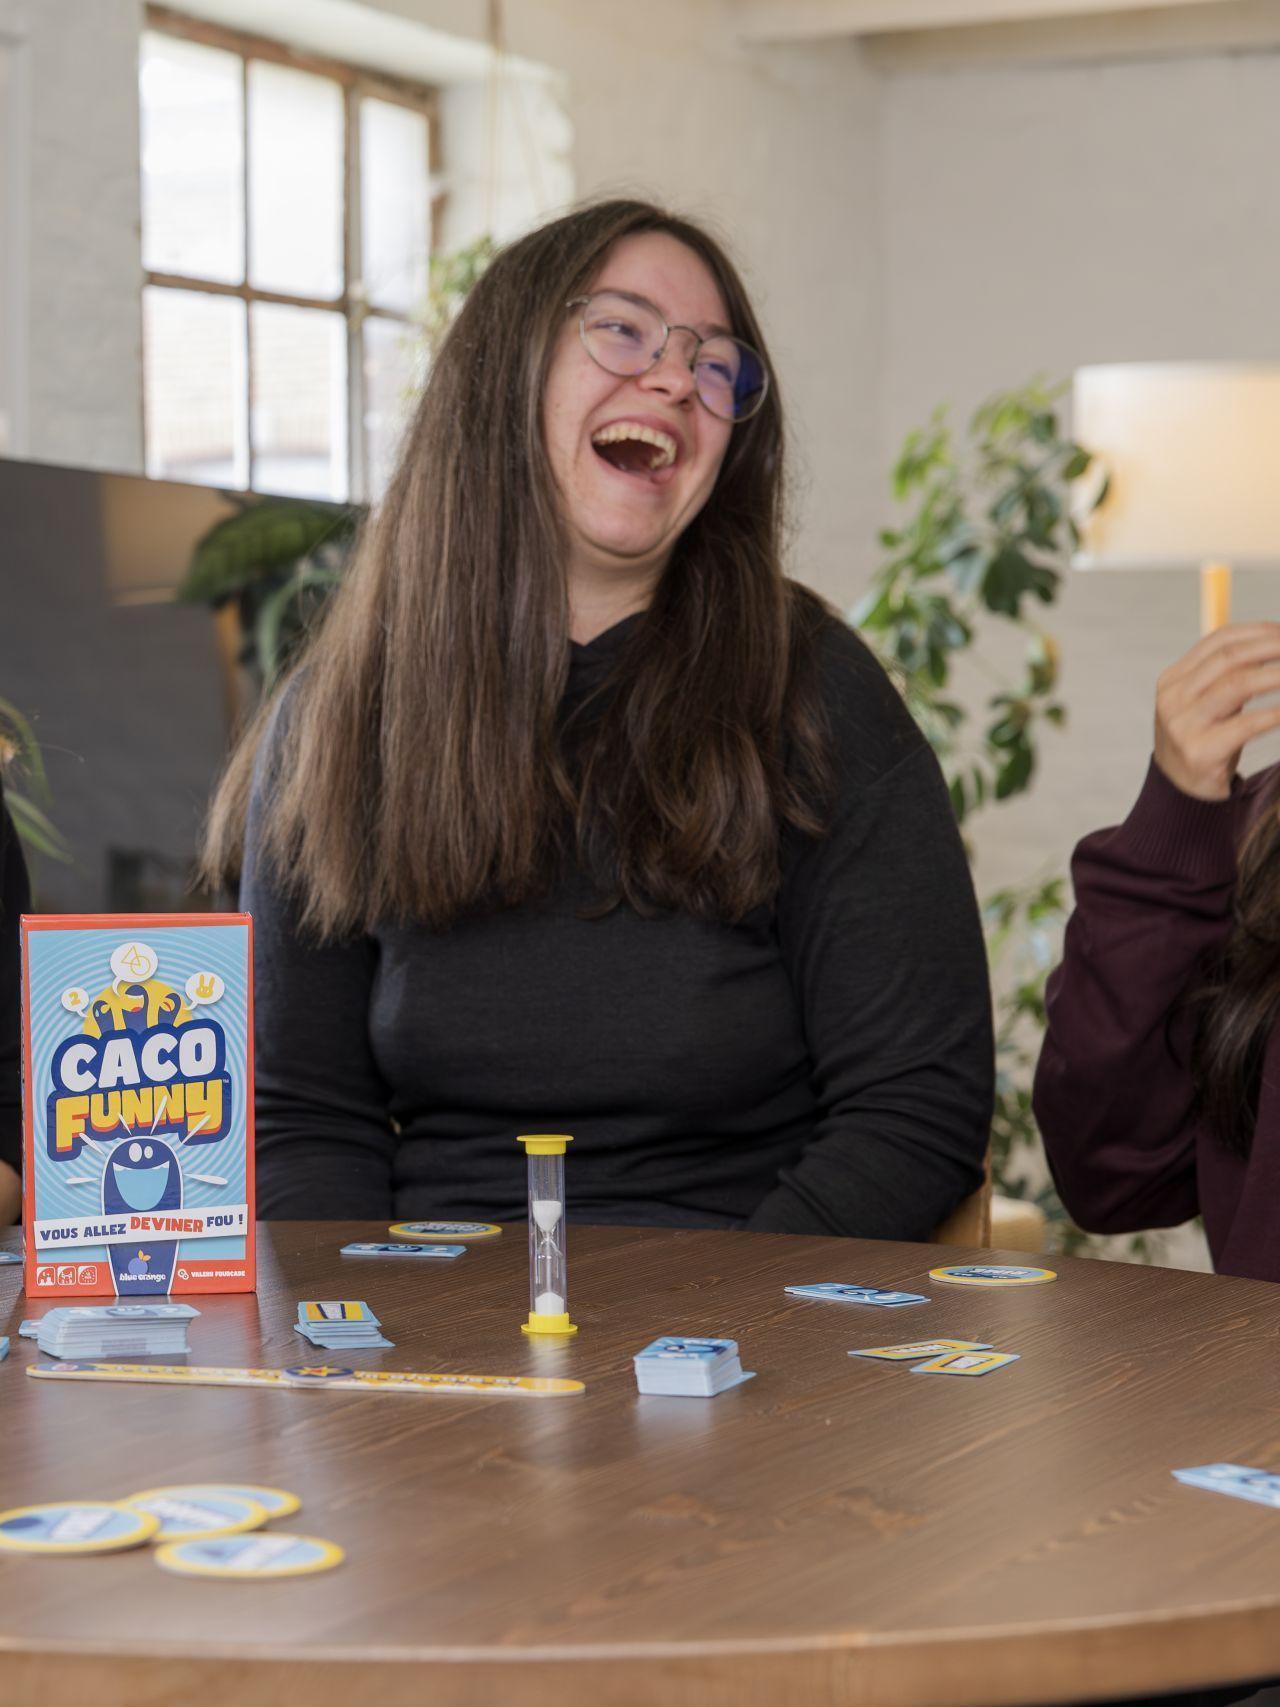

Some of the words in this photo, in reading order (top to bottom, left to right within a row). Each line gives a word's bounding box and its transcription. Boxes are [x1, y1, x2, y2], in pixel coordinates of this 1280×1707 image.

[68, 991, 81, 1006] 2
[60, 1027, 217, 1092] CACO
[55, 1079, 223, 1152] FUNNY
[40, 1227, 78, 1241] VOUS
[83, 1223, 127, 1238] ALLEZ
[130, 1216, 204, 1233] DEVINER
[206, 1214, 234, 1228] FOU
[238, 1213, 244, 1225] !
[119, 1272, 138, 1281] blue
[138, 1273, 166, 1283] orange
